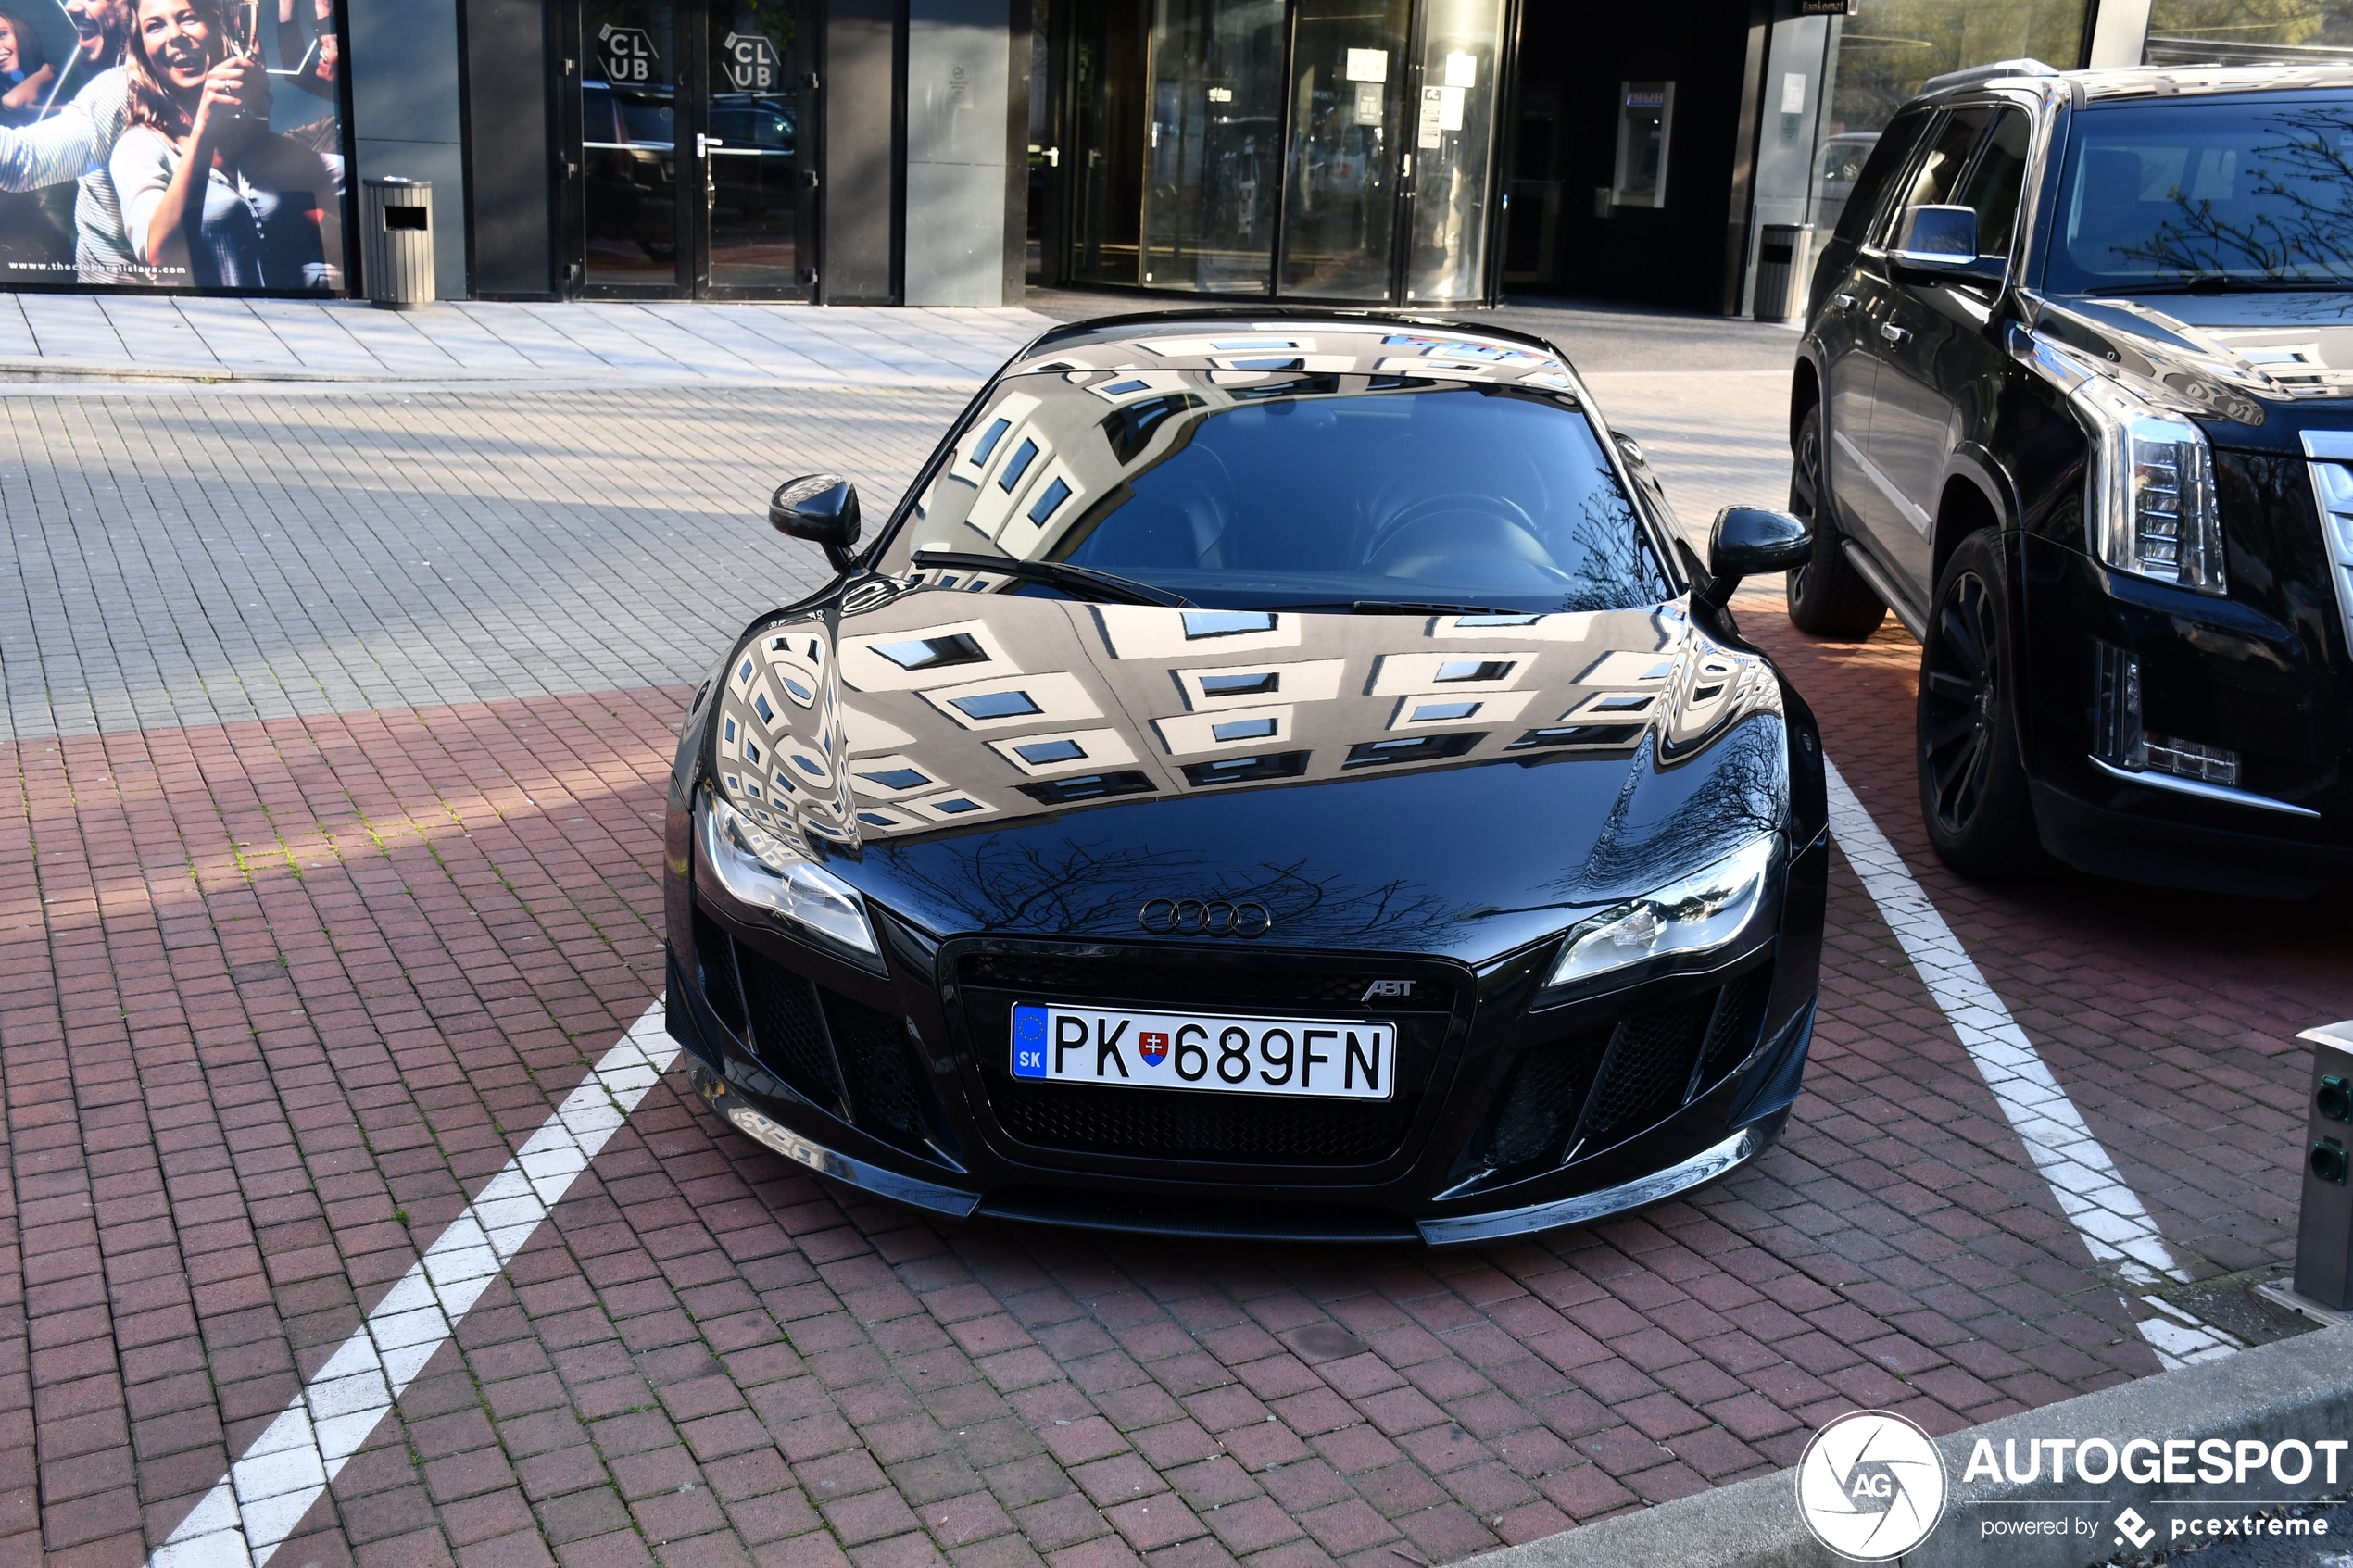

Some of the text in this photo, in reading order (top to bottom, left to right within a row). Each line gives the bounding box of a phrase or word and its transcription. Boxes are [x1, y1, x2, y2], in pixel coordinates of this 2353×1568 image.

[1802, 1, 1844, 12] Bankomat
[1361, 980, 1417, 1002] ABT
[1019, 1051, 1040, 1068] SK
